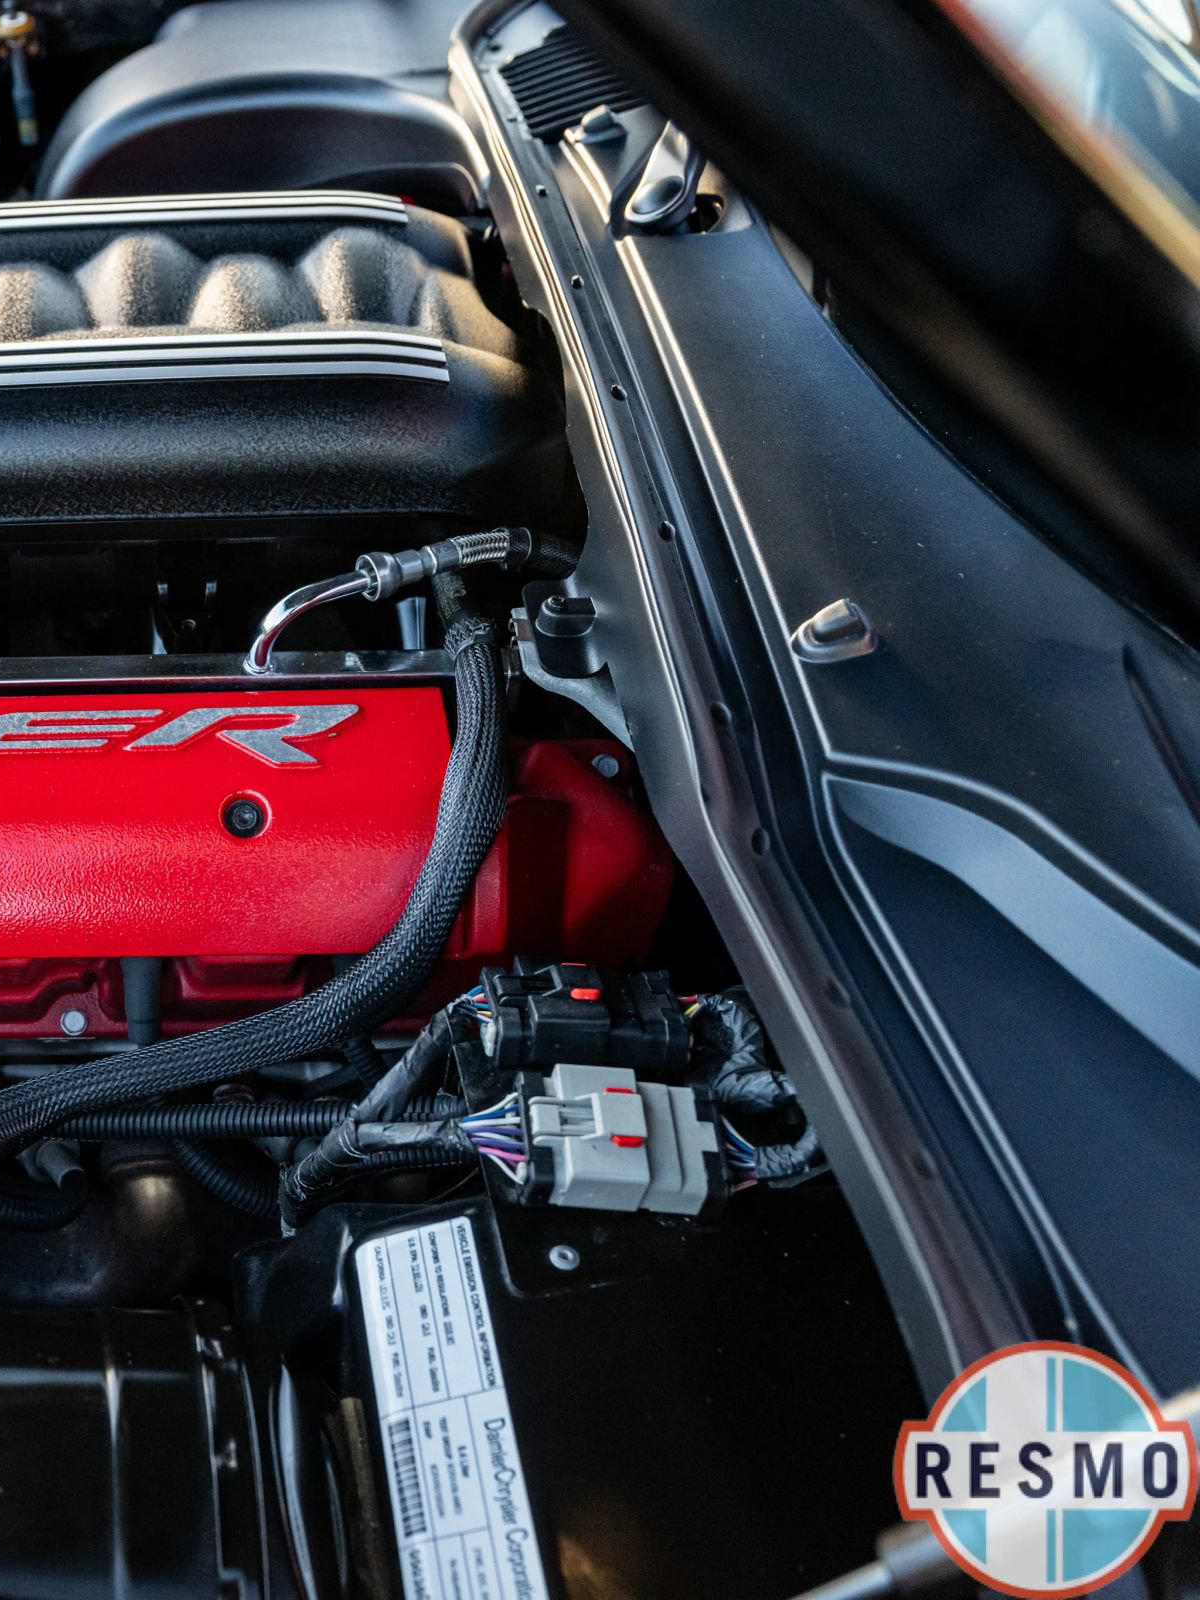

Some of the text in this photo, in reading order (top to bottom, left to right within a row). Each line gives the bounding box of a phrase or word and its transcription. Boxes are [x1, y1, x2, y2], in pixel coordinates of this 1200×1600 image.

[457, 1224, 496, 1387] VEHICLE EMISSION CONTROL INFORMATION
[484, 1418, 517, 1525] DaimlerChrysler
